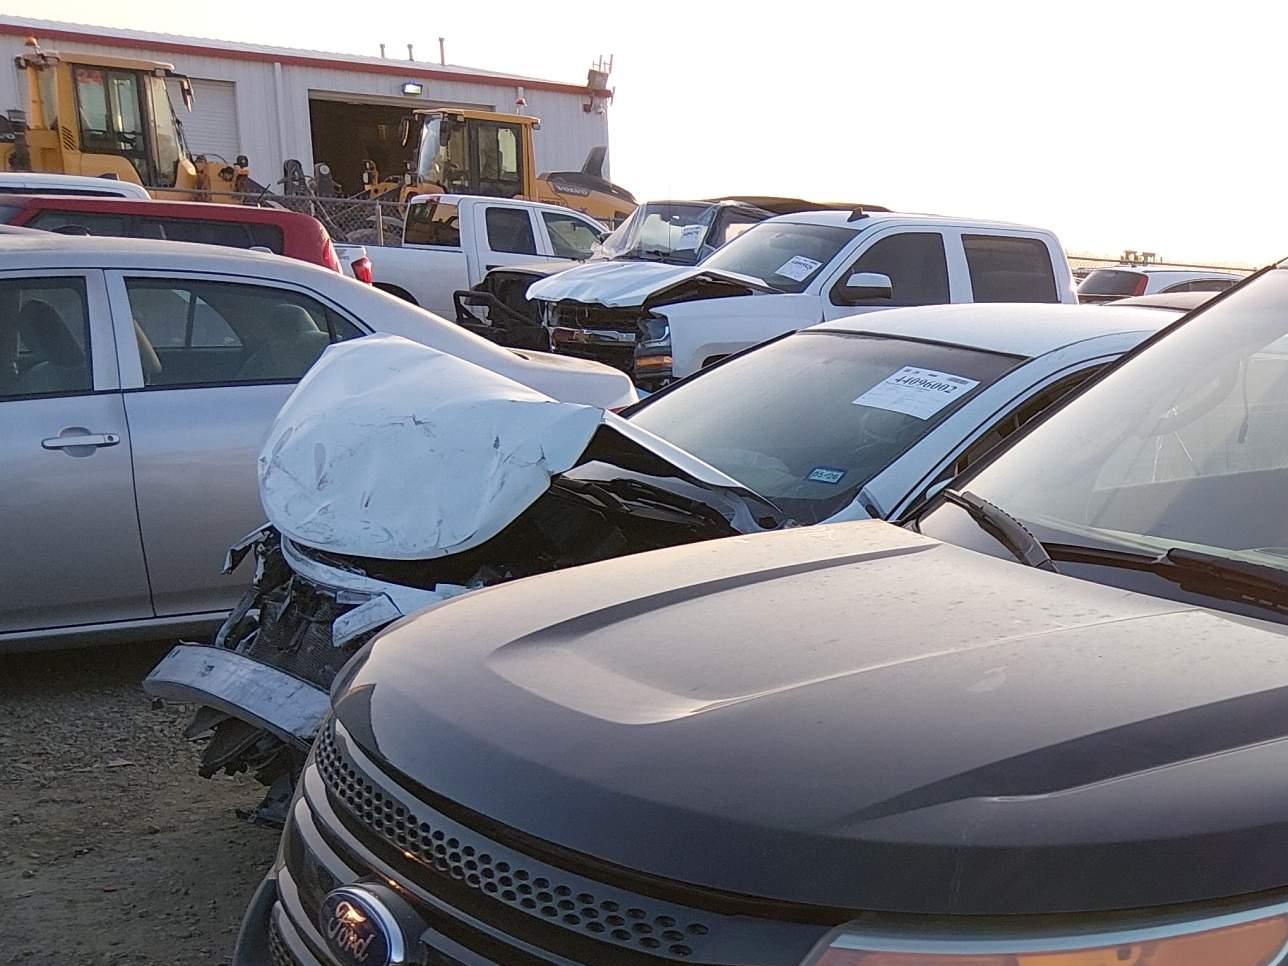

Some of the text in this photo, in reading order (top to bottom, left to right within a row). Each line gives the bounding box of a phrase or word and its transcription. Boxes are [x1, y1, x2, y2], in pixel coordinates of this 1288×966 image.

[556, 185, 588, 195] VOLVO
[894, 375, 958, 394] 44096002
[327, 901, 376, 962] Ford
